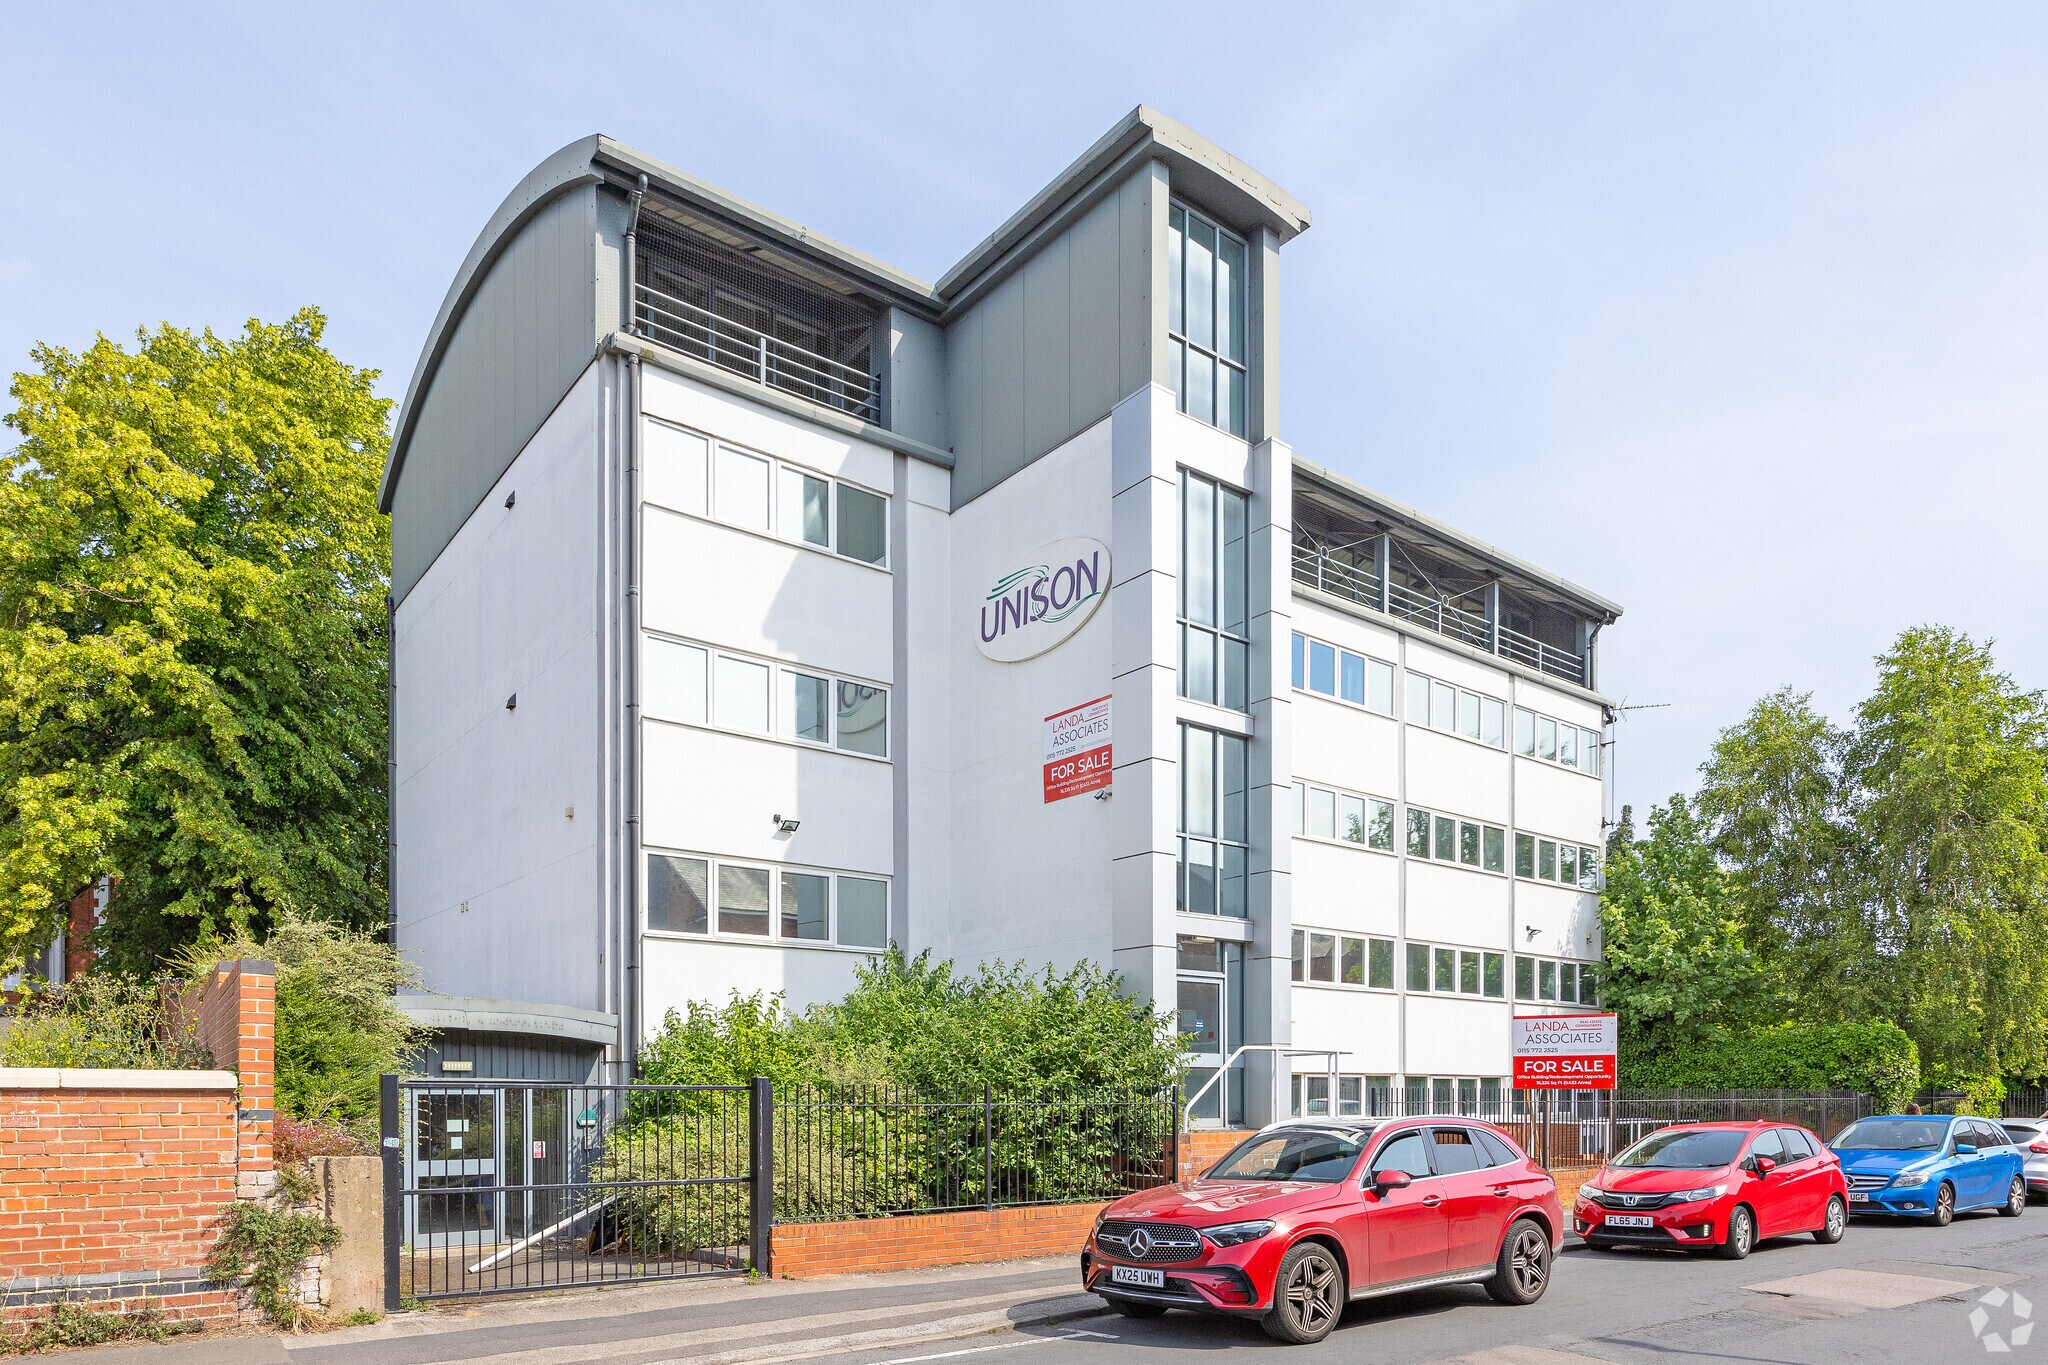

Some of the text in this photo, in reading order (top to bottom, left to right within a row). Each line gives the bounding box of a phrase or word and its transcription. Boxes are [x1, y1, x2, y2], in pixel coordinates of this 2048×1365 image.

[980, 551, 1098, 643] UNISON
[1052, 712, 1085, 734] LANDA
[1052, 718, 1109, 748] ASSOCIATES
[1051, 751, 1109, 782] FOR SALE
[1525, 1021, 1570, 1032] LANDA
[1525, 1032, 1603, 1045] ASSOCIATES
[1524, 1060, 1604, 1073] FOR SALE
[1608, 1216, 1649, 1226] FL65 JNJ
[1116, 1267, 1159, 1285] KX25 UWH
